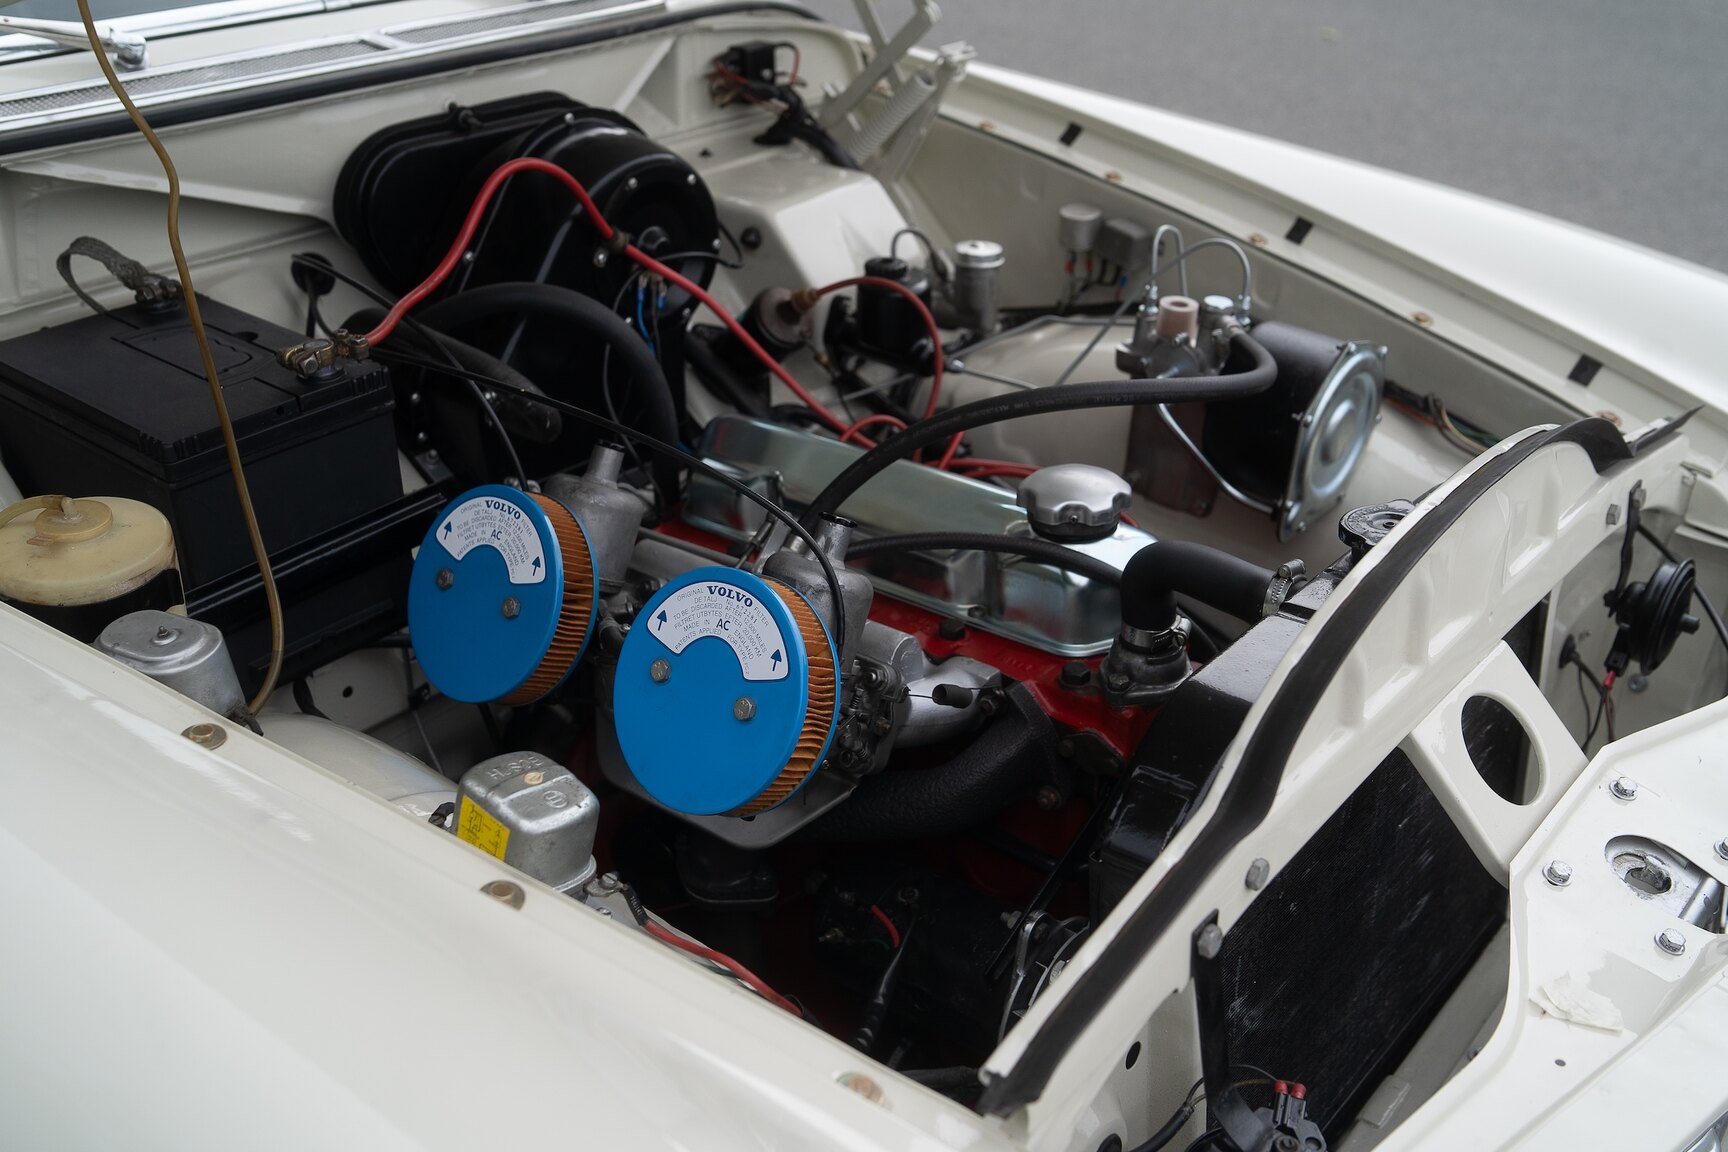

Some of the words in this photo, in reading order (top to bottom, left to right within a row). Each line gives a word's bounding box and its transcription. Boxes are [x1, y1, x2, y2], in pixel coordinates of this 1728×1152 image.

[485, 500, 520, 520] VOLVO
[521, 519, 532, 536] FILTER
[498, 518, 512, 528] AFTER
[498, 525, 511, 537] EFTER
[465, 532, 477, 541] MADE
[491, 529, 502, 540] AC
[504, 539, 519, 566] ENGLAND
[499, 544, 507, 554] FOR
[677, 589, 703, 601] ORIGINAL
[707, 586, 753, 607] VOLVO
[754, 607, 769, 626] FILTER
[736, 605, 758, 623] 672281
[674, 615, 695, 629] FILTRET
[725, 614, 742, 628] EFTER
[754, 646, 762, 658] KM
[675, 631, 696, 649] PATENTS
[727, 635, 737, 645] FOR
[737, 645, 748, 660] TYPE
[683, 621, 699, 631] MADE
[716, 619, 730, 630] AC
[734, 630, 753, 660] ENGLAND
[691, 603, 723, 612] DISCARDED
[725, 607, 742, 617] AFTER
[755, 633, 767, 652] MILES
